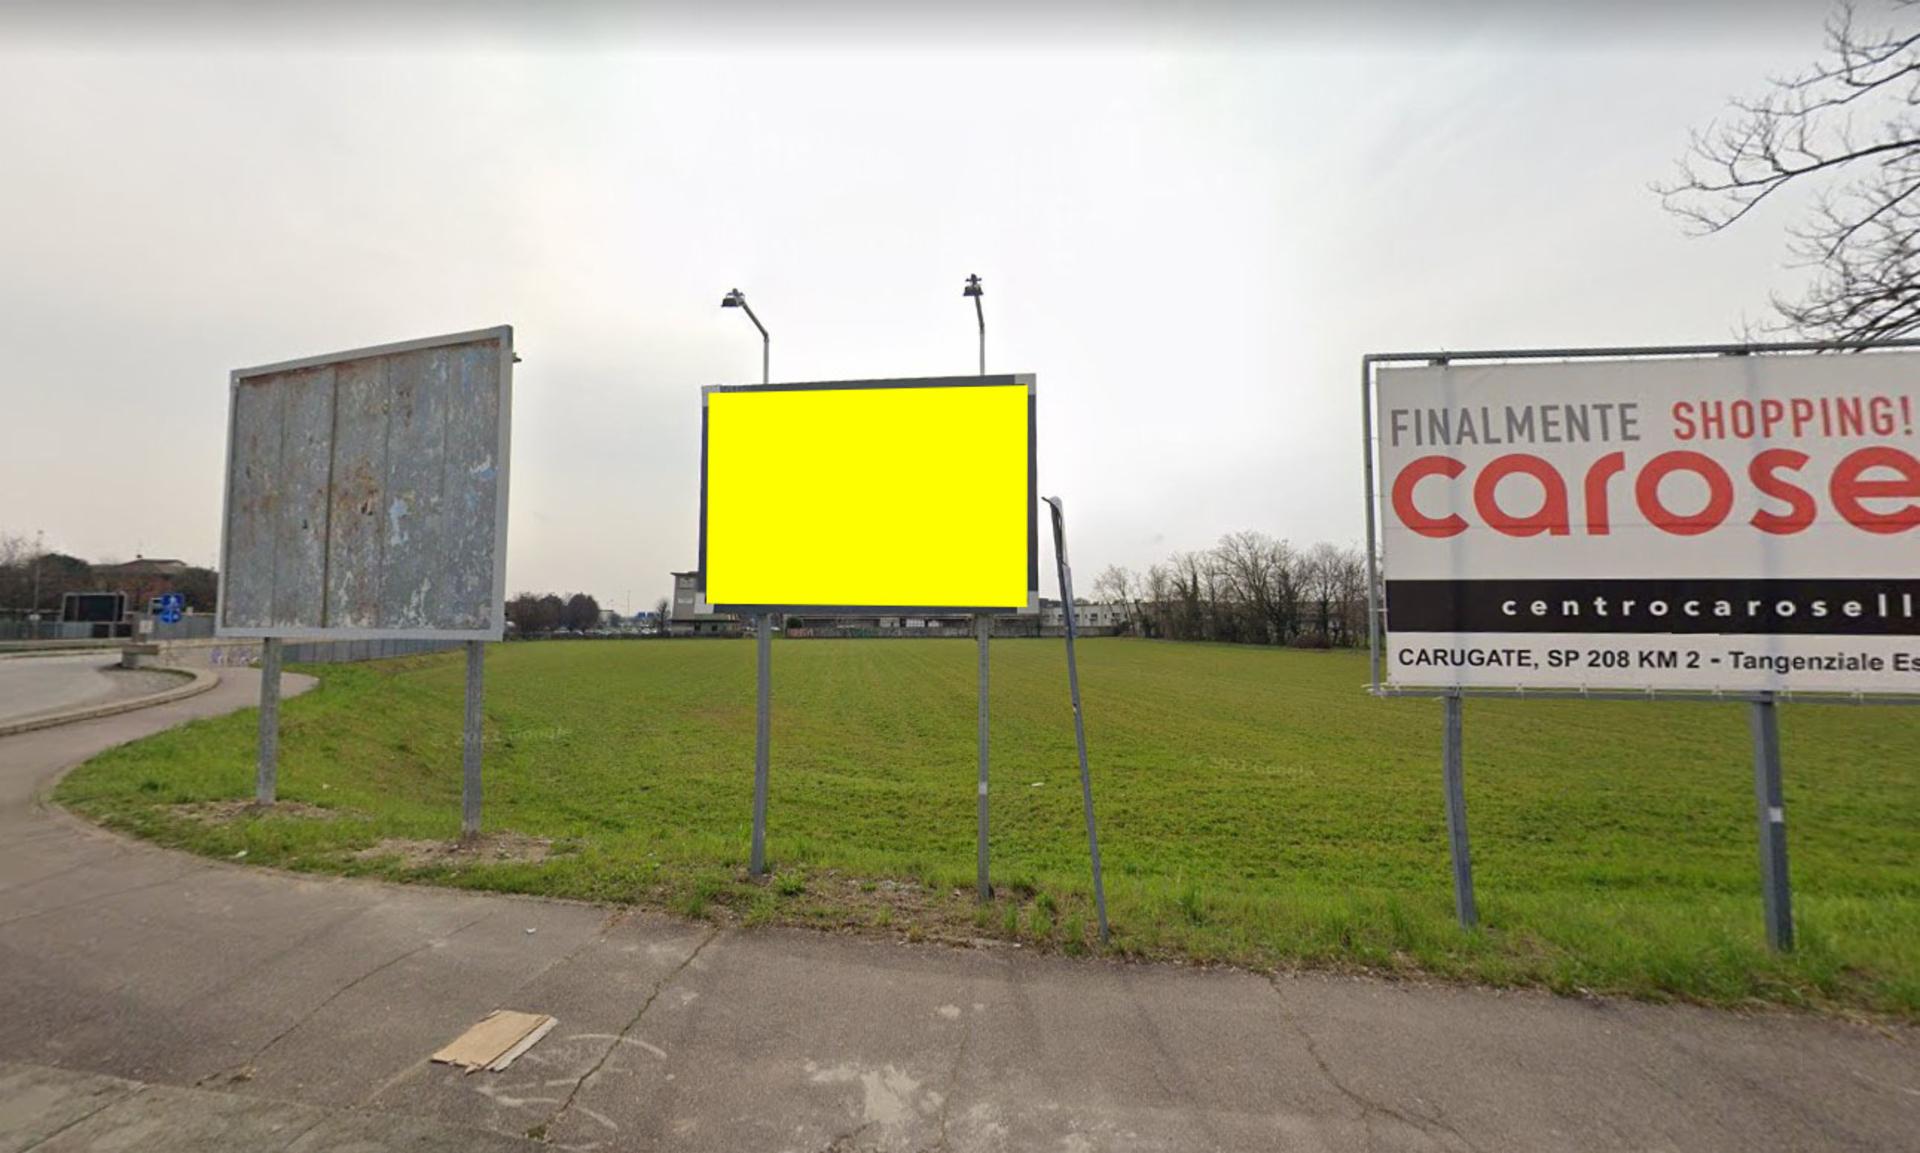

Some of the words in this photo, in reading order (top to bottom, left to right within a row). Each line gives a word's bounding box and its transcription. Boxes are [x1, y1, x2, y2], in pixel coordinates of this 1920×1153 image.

[1391, 403, 1640, 447] FINALMENTE
[1672, 395, 1913, 440] SHOPPING!
[1391, 445, 1920, 538] carose
[1502, 593, 1912, 617] centrocarosell
[1398, 648, 1538, 670] CARUGATE,
[1547, 650, 1579, 668] SP
[1587, 650, 1630, 668] 208
[1638, 650, 1678, 668] KM
[1686, 650, 1700, 668] 2
[1728, 651, 1884, 674] Tangenziale
